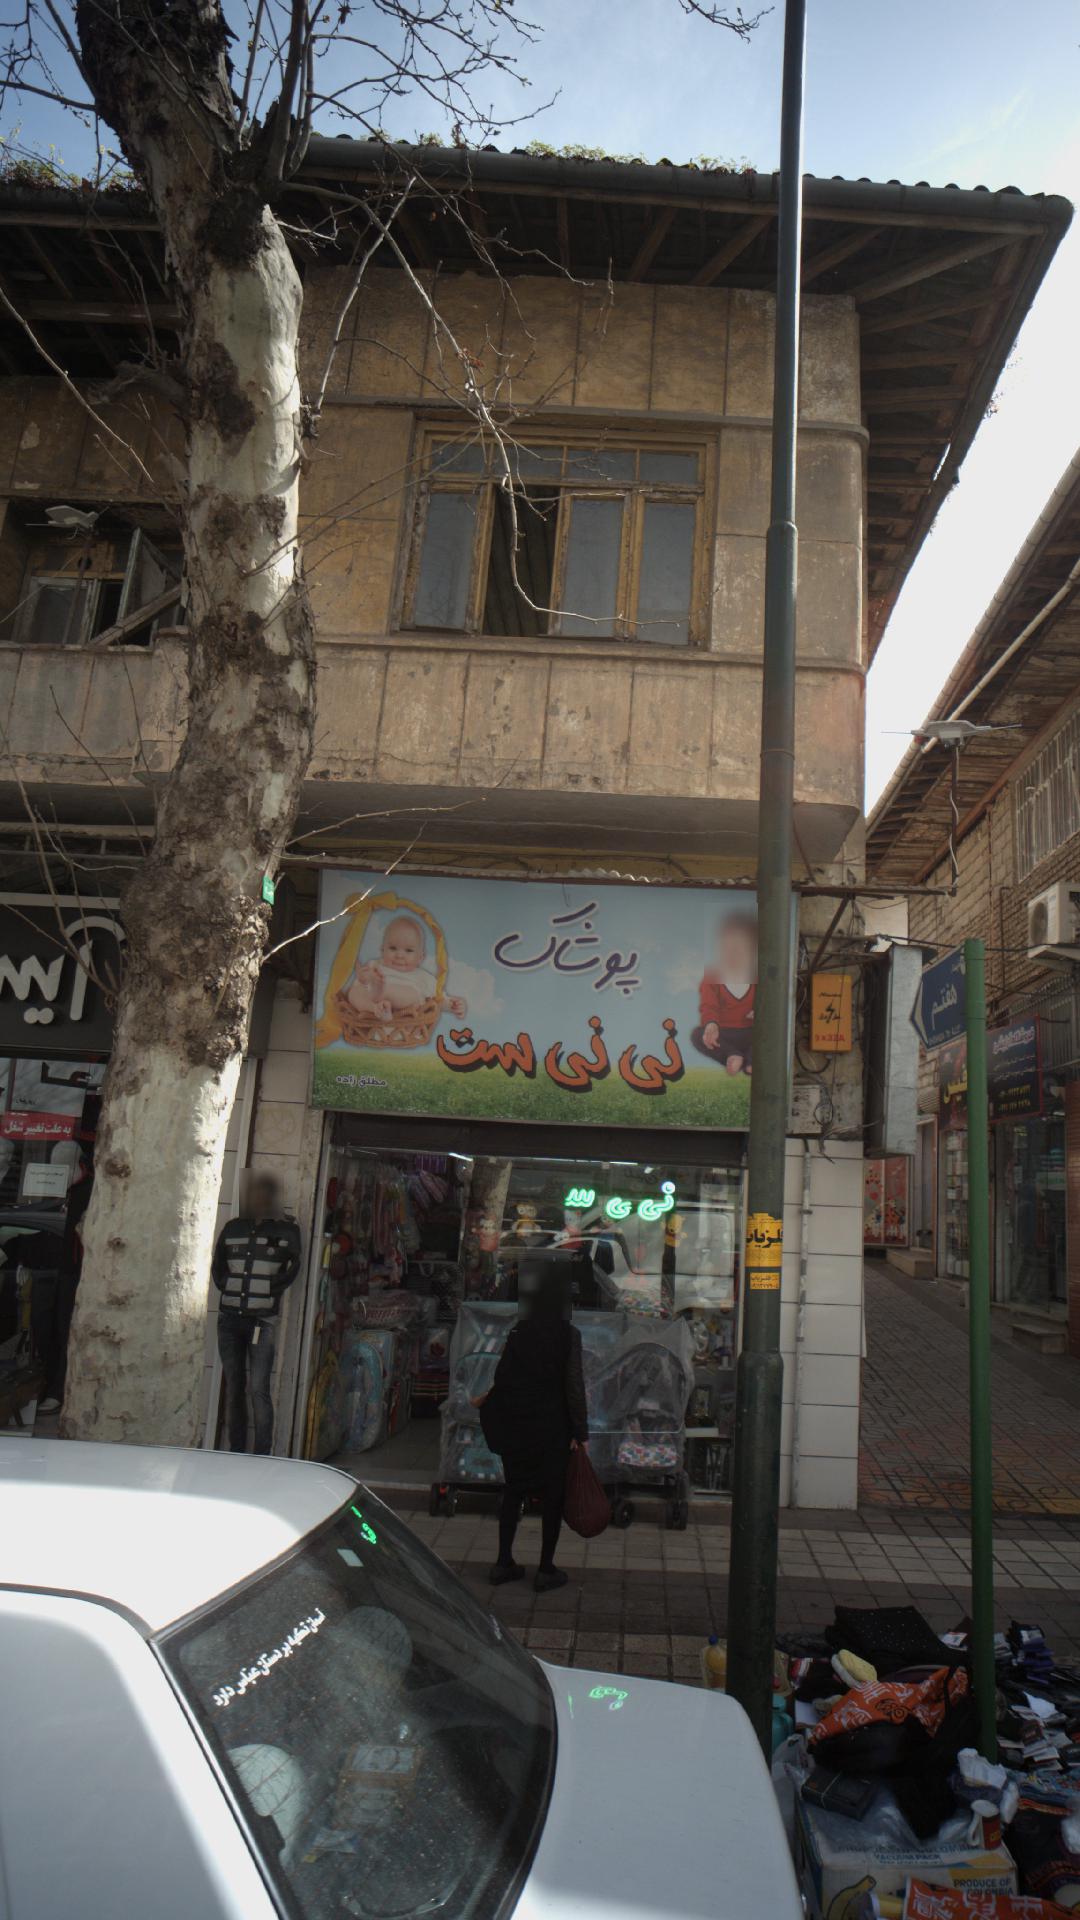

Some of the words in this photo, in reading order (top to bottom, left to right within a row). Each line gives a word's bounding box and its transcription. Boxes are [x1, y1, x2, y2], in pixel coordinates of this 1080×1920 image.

[494, 900, 640, 996] پوشاک
[436, 1026, 537, 1079] ست
[544, 1015, 611, 1093] نی
[618, 1017, 686, 1096] نی
[24, 1122, 45, 1136] تغییر
[45, 1122, 62, 1134] علت
[63, 1127, 72, 1137] به
[637, 1181, 676, 1221] نی
[953, 1879, 996, 1888] PRODUCE
[999, 1878, 1011, 1887] OF
